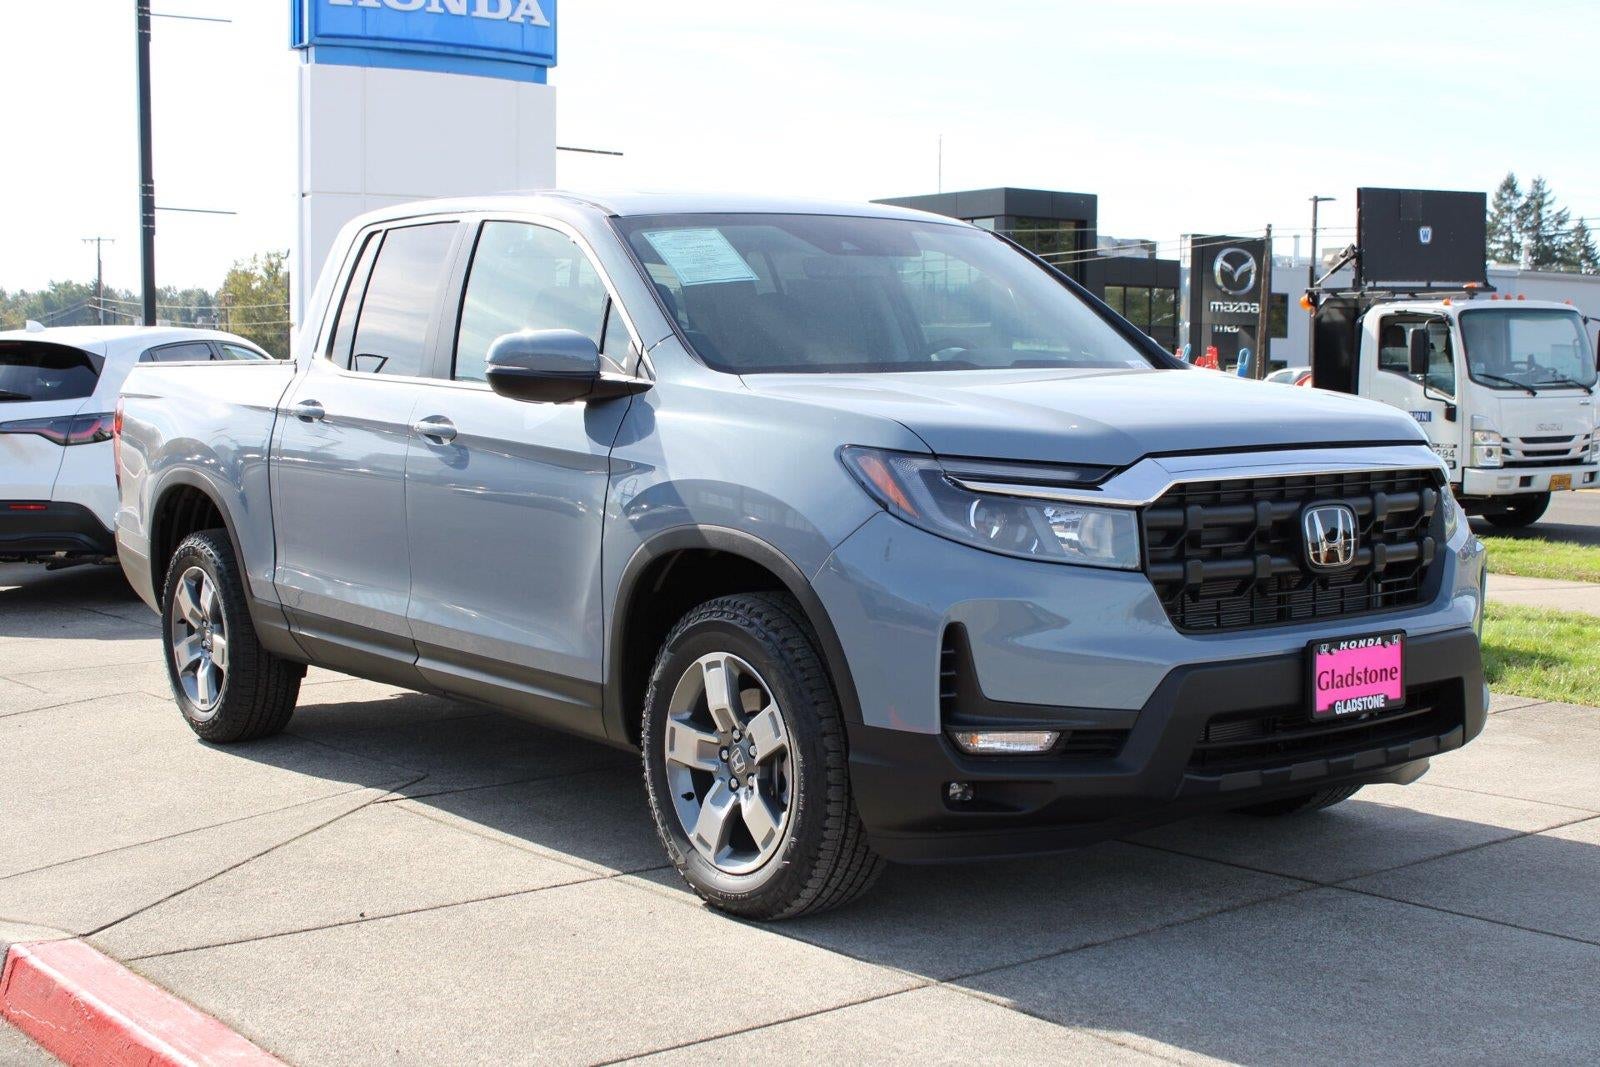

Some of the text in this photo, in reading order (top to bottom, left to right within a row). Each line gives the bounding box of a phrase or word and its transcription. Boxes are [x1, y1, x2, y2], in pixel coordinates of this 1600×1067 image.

[1340, 638, 1382, 650] HONDA
[1317, 666, 1398, 691] Gladstone
[1335, 694, 1385, 715] GLADSTONE
